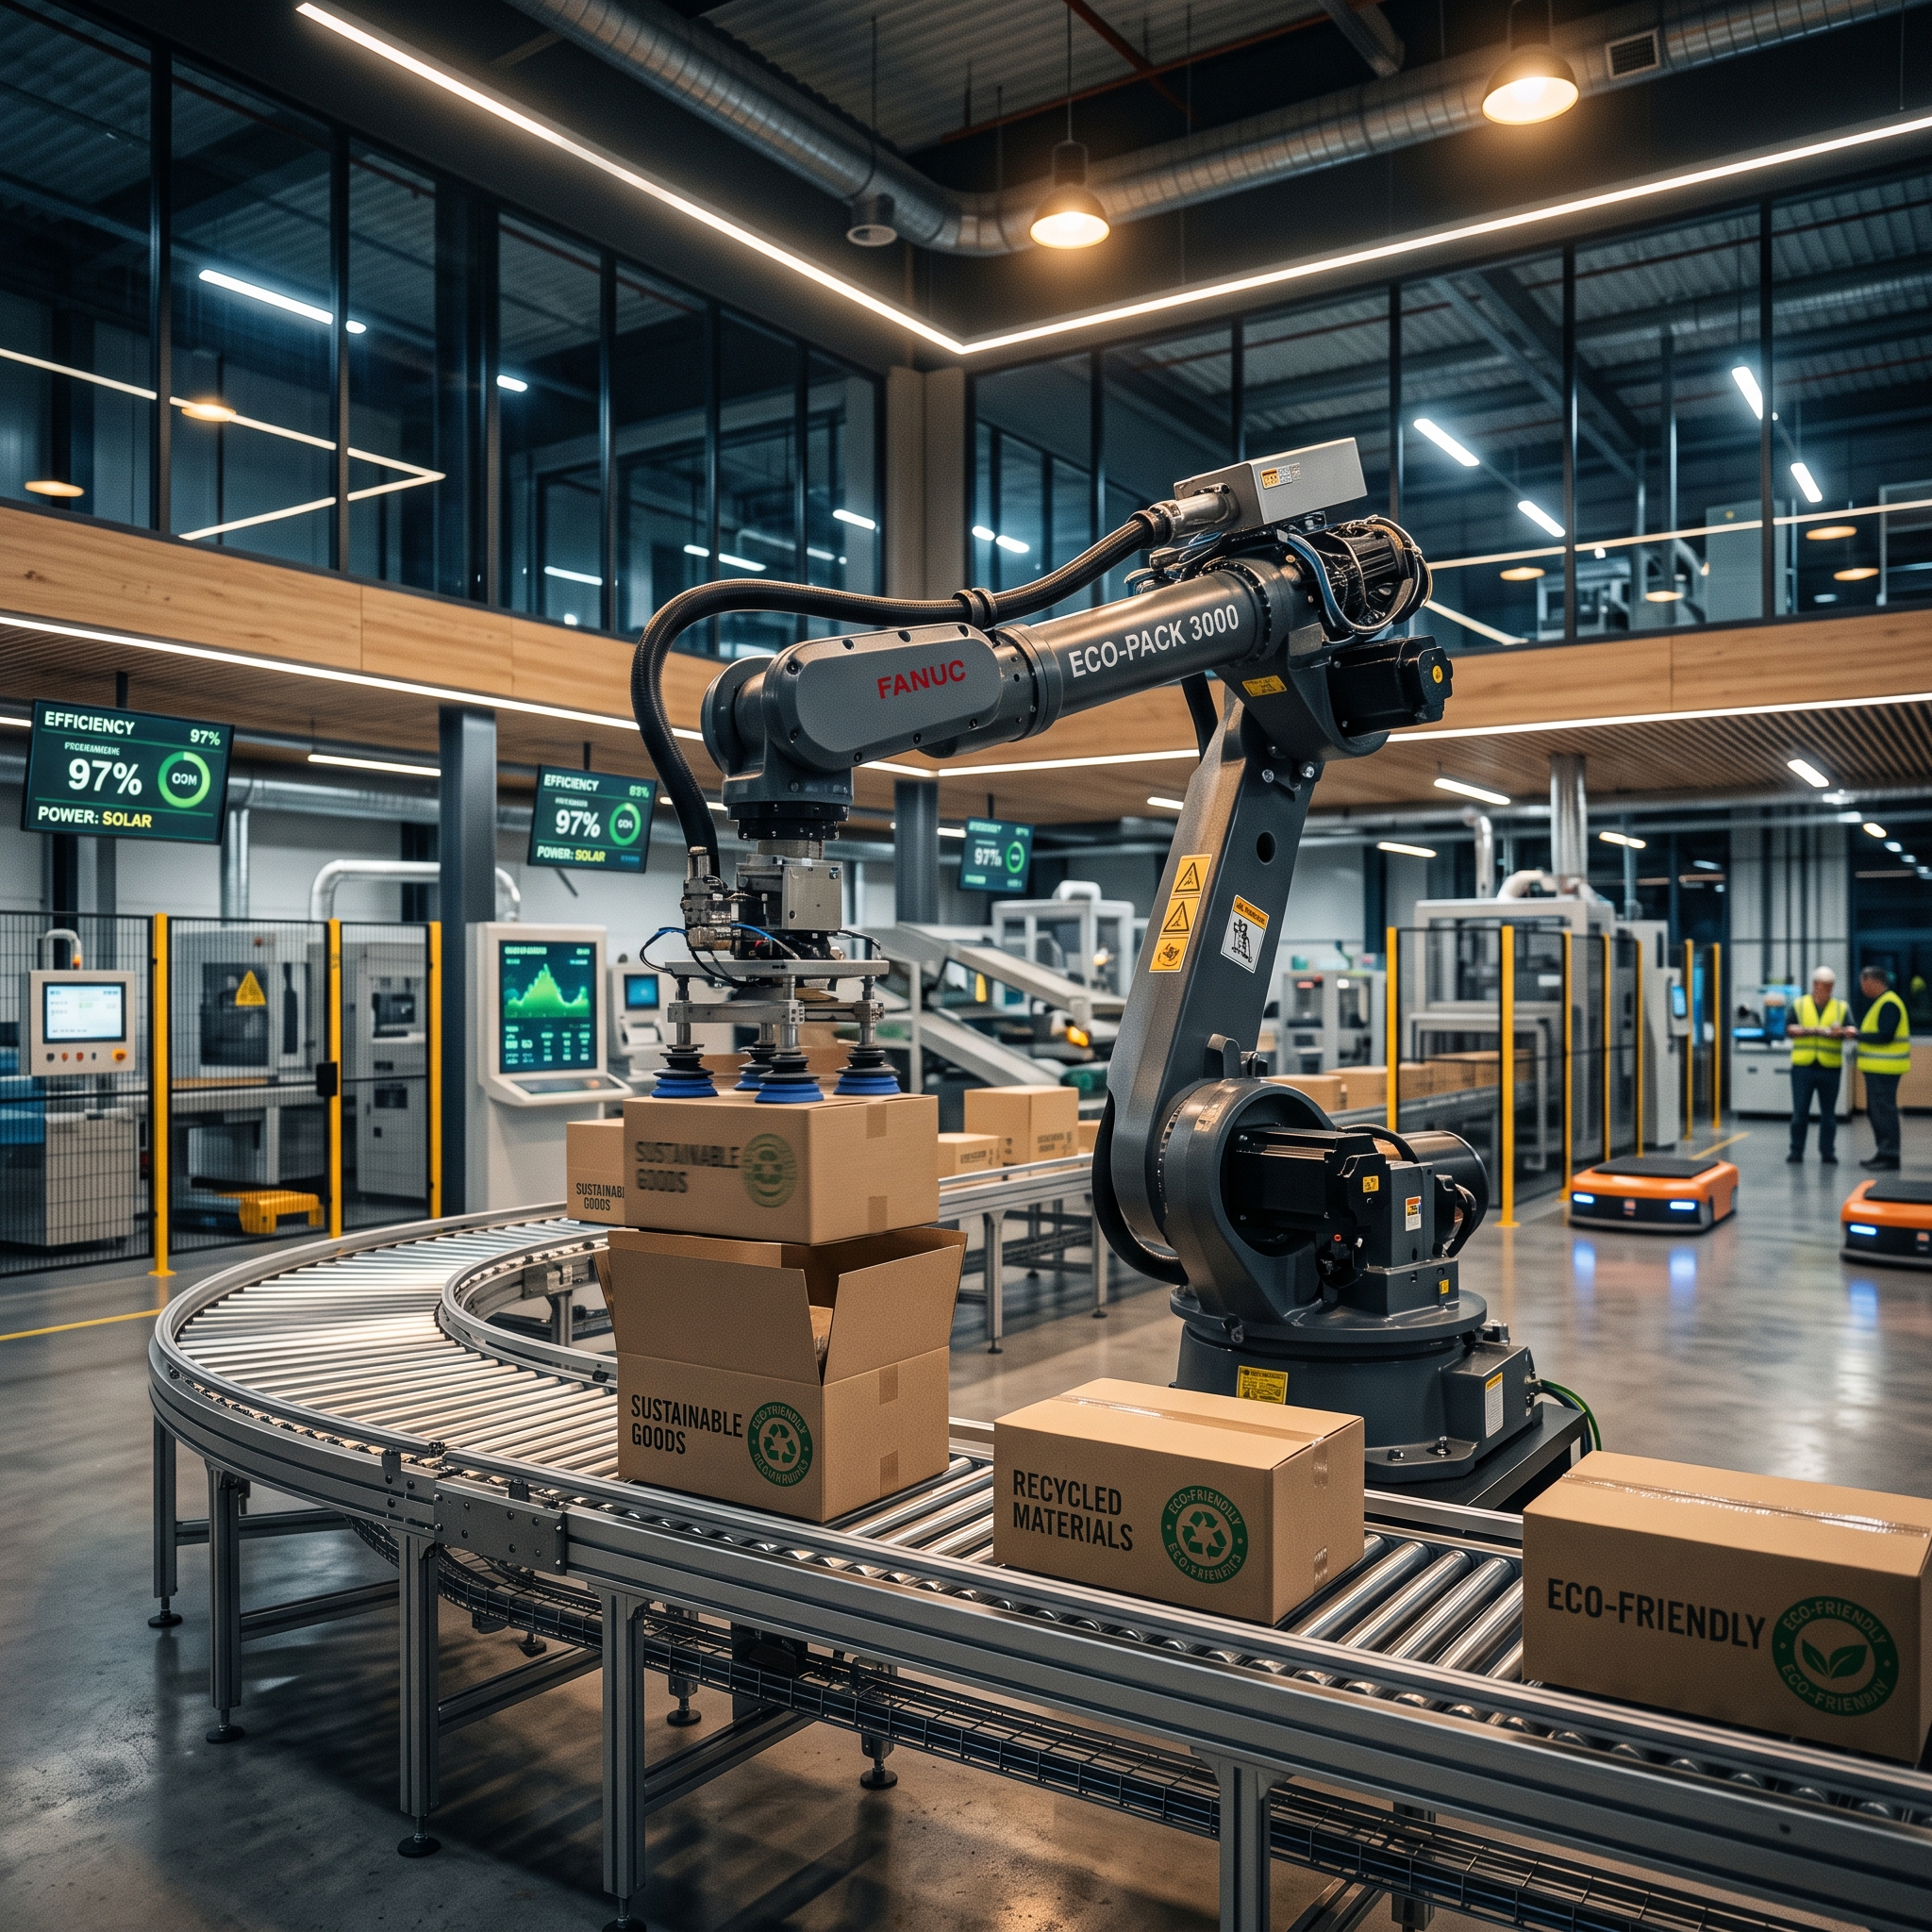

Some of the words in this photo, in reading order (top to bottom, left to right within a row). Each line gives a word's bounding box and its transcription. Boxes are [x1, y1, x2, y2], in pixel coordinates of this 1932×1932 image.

[1068, 619, 1187, 678] ECO-PACK
[1191, 604, 1240, 642] 3000
[876, 658, 967, 700] FANUC
[44, 710, 135, 735] EFFICIENCY
[190, 728, 221, 746] 97%
[68, 758, 142, 796] 97%
[543, 774, 599, 791] EFFICIENCY
[38, 806, 99, 824] POWER:
[102, 810, 152, 828] SOLAR
[555, 808, 601, 838] 97%
[537, 845, 574, 860] POWER:
[575, 849, 606, 862] SOLAR
[974, 846, 1002, 867] 97%
[631, 1394, 743, 1439] SUSTAINABLE
[631, 1422, 687, 1455] GOODS
[1013, 1469, 1123, 1516] RECYCLED
[1013, 1501, 1133, 1552] MATERIALS
[1547, 1577, 1766, 1651] ECO-FRIENDLY
[1782, 1601, 1888, 1643] ECO-FRIENDLY
